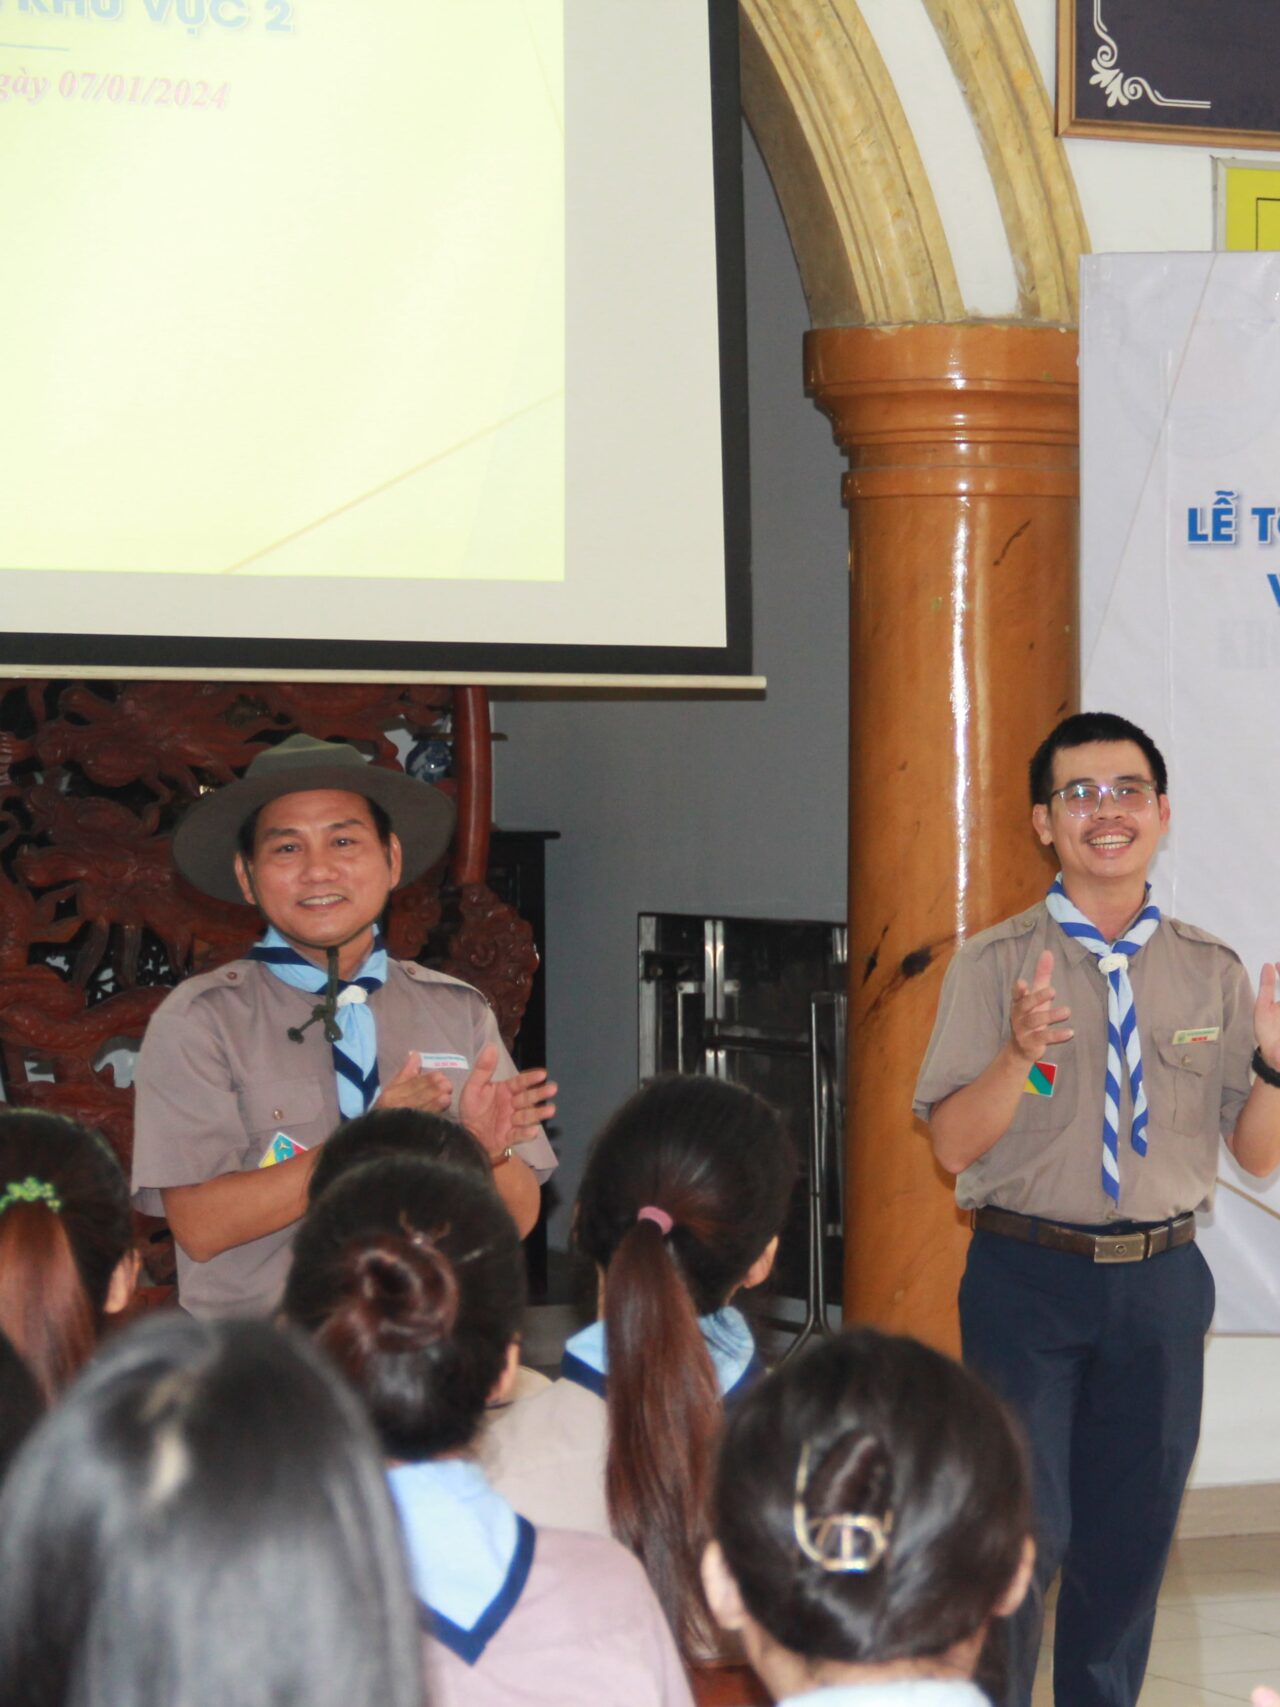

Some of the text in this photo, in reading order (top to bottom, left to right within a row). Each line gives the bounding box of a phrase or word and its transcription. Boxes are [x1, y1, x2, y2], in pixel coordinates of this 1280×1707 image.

[265, 0, 292, 32] 2
[58, 71, 231, 109] 07/01/2024
[1187, 490, 1235, 542] LỄ
